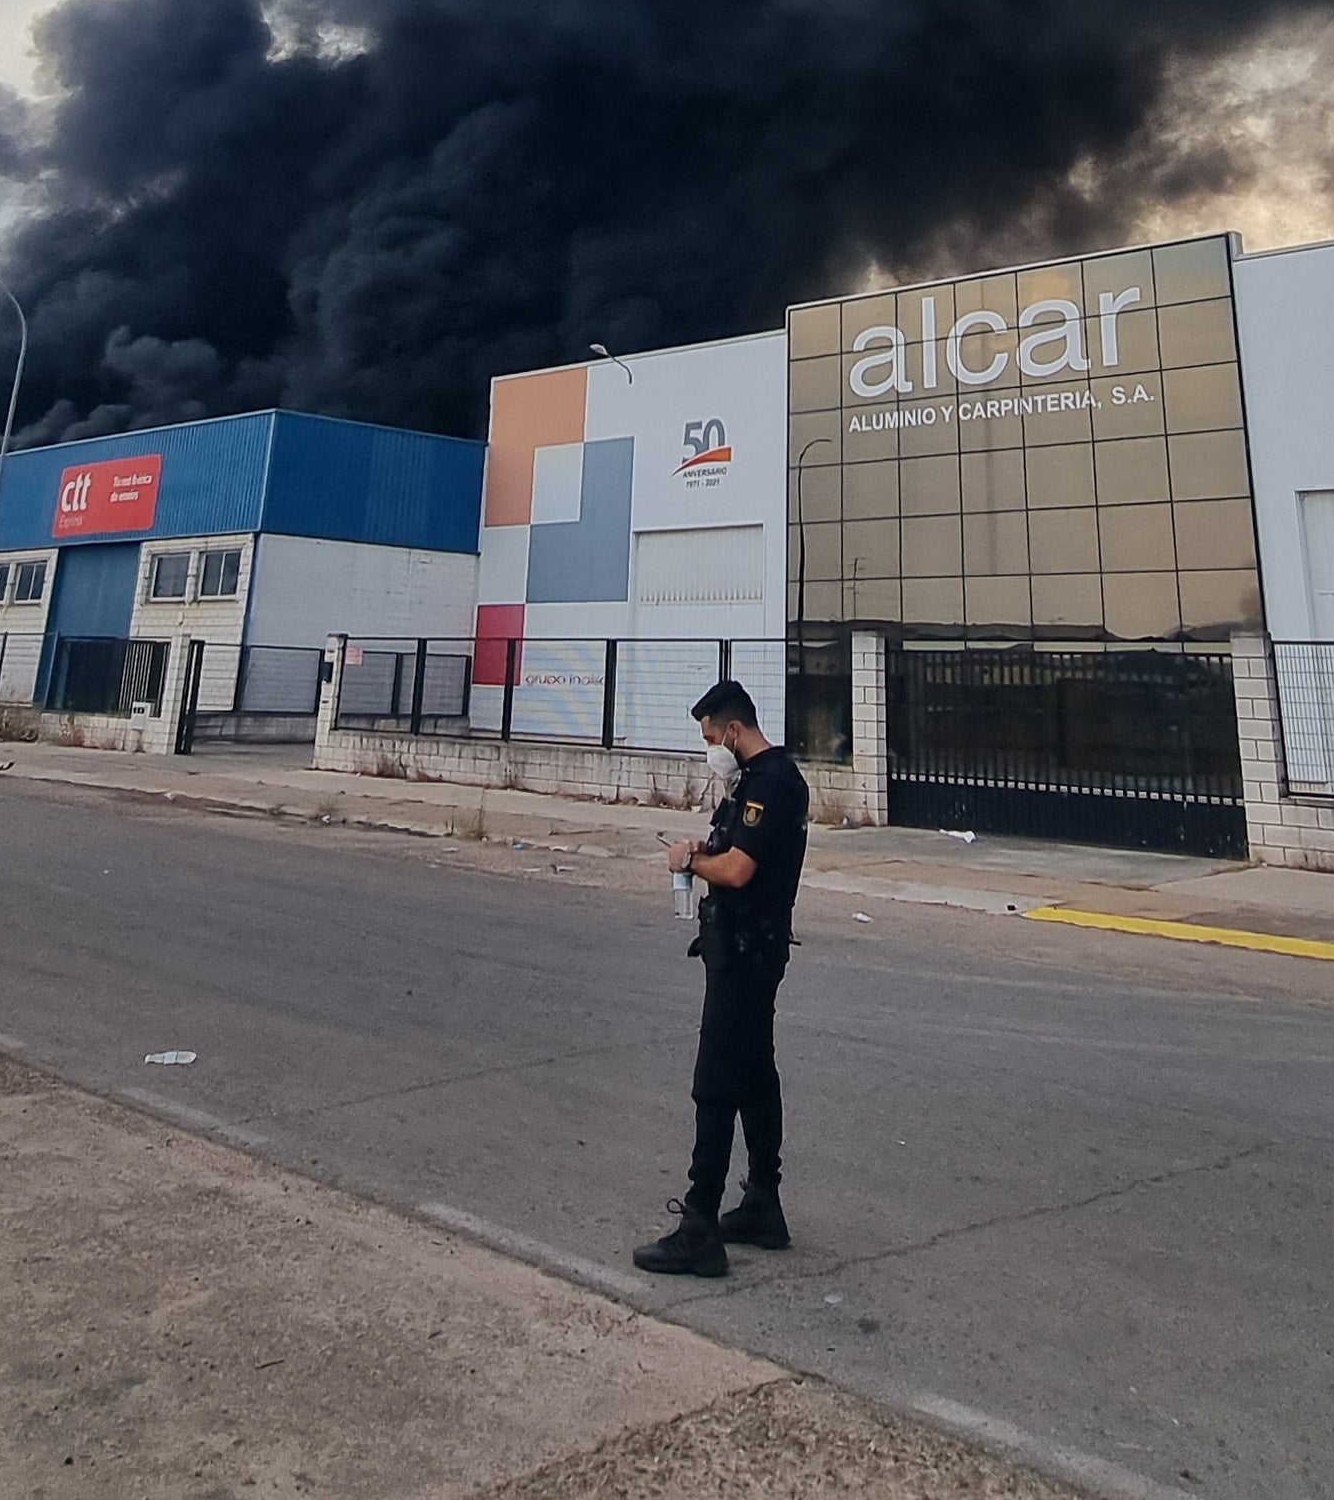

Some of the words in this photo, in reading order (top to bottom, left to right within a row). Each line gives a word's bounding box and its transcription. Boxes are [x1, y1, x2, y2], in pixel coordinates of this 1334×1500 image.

[849, 287, 1141, 398] alcar
[848, 406, 937, 433] ALUMINIO
[936, 404, 954, 423] Y
[1111, 383, 1156, 405] S.A.
[681, 418, 726, 465] 50
[61, 471, 92, 513] ctt
[682, 466, 727, 479] ANIVERSARIO
